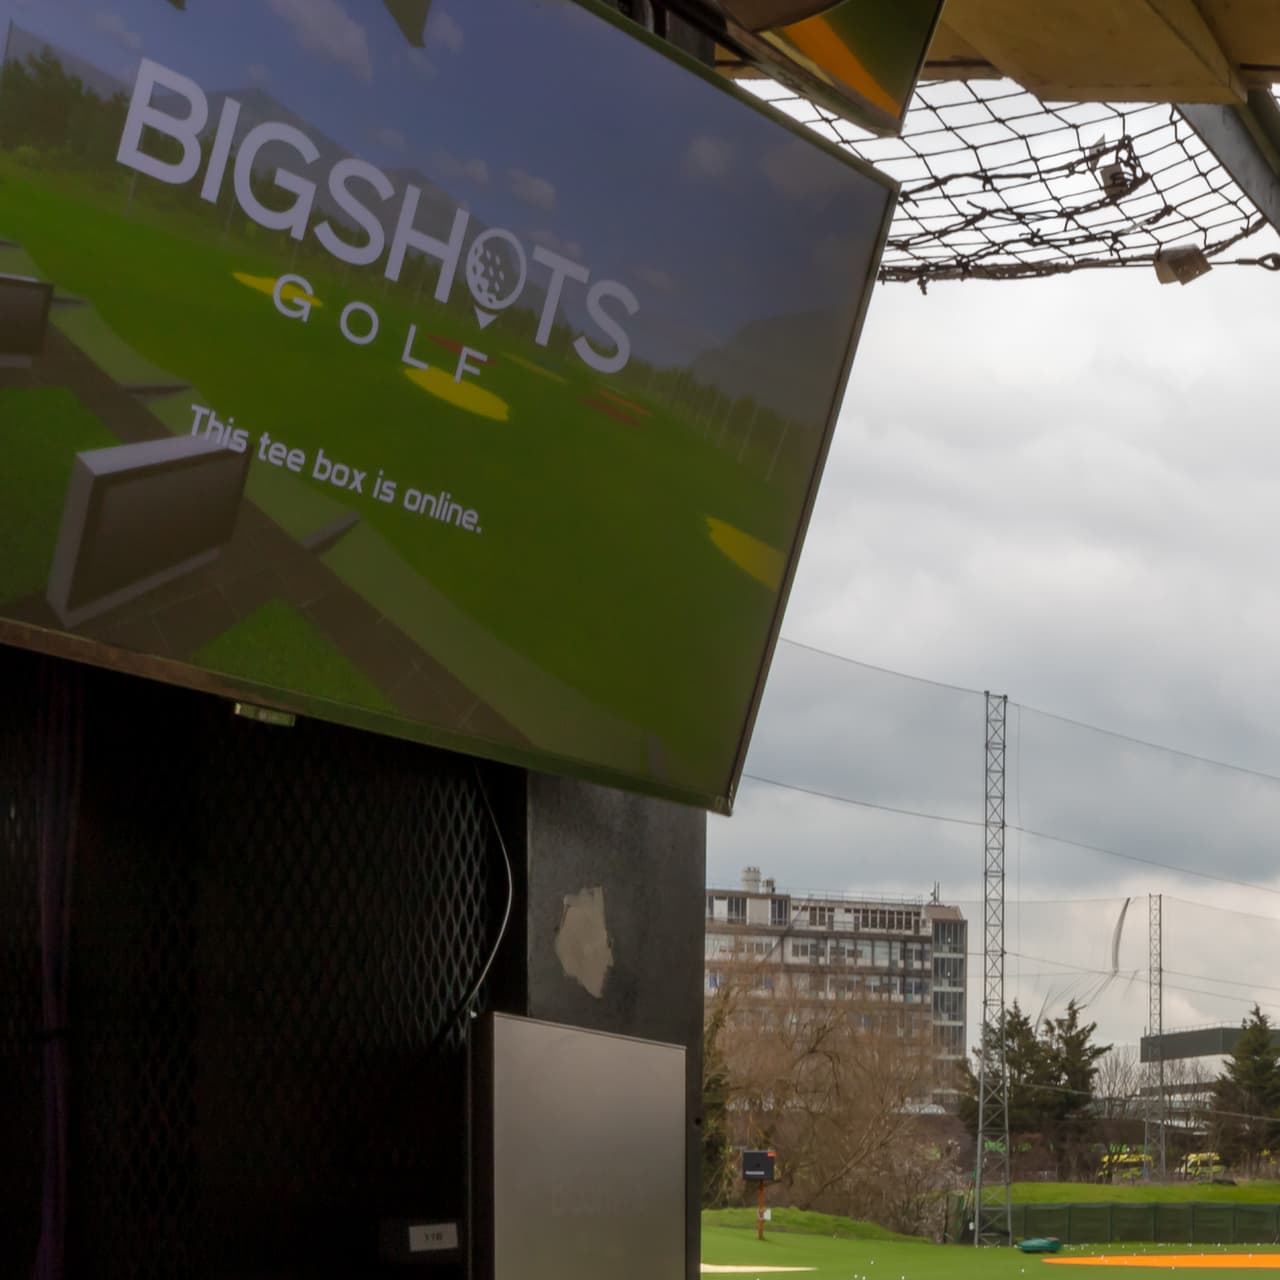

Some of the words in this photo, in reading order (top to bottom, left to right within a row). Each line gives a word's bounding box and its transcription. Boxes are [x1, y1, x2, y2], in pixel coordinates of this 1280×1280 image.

[116, 57, 640, 374] BIGSHOTS
[273, 273, 488, 384] GOLF
[191, 404, 249, 453] This
[257, 432, 305, 472] tee
[312, 448, 367, 493] box
[372, 469, 397, 503] is
[403, 480, 482, 534] online.
